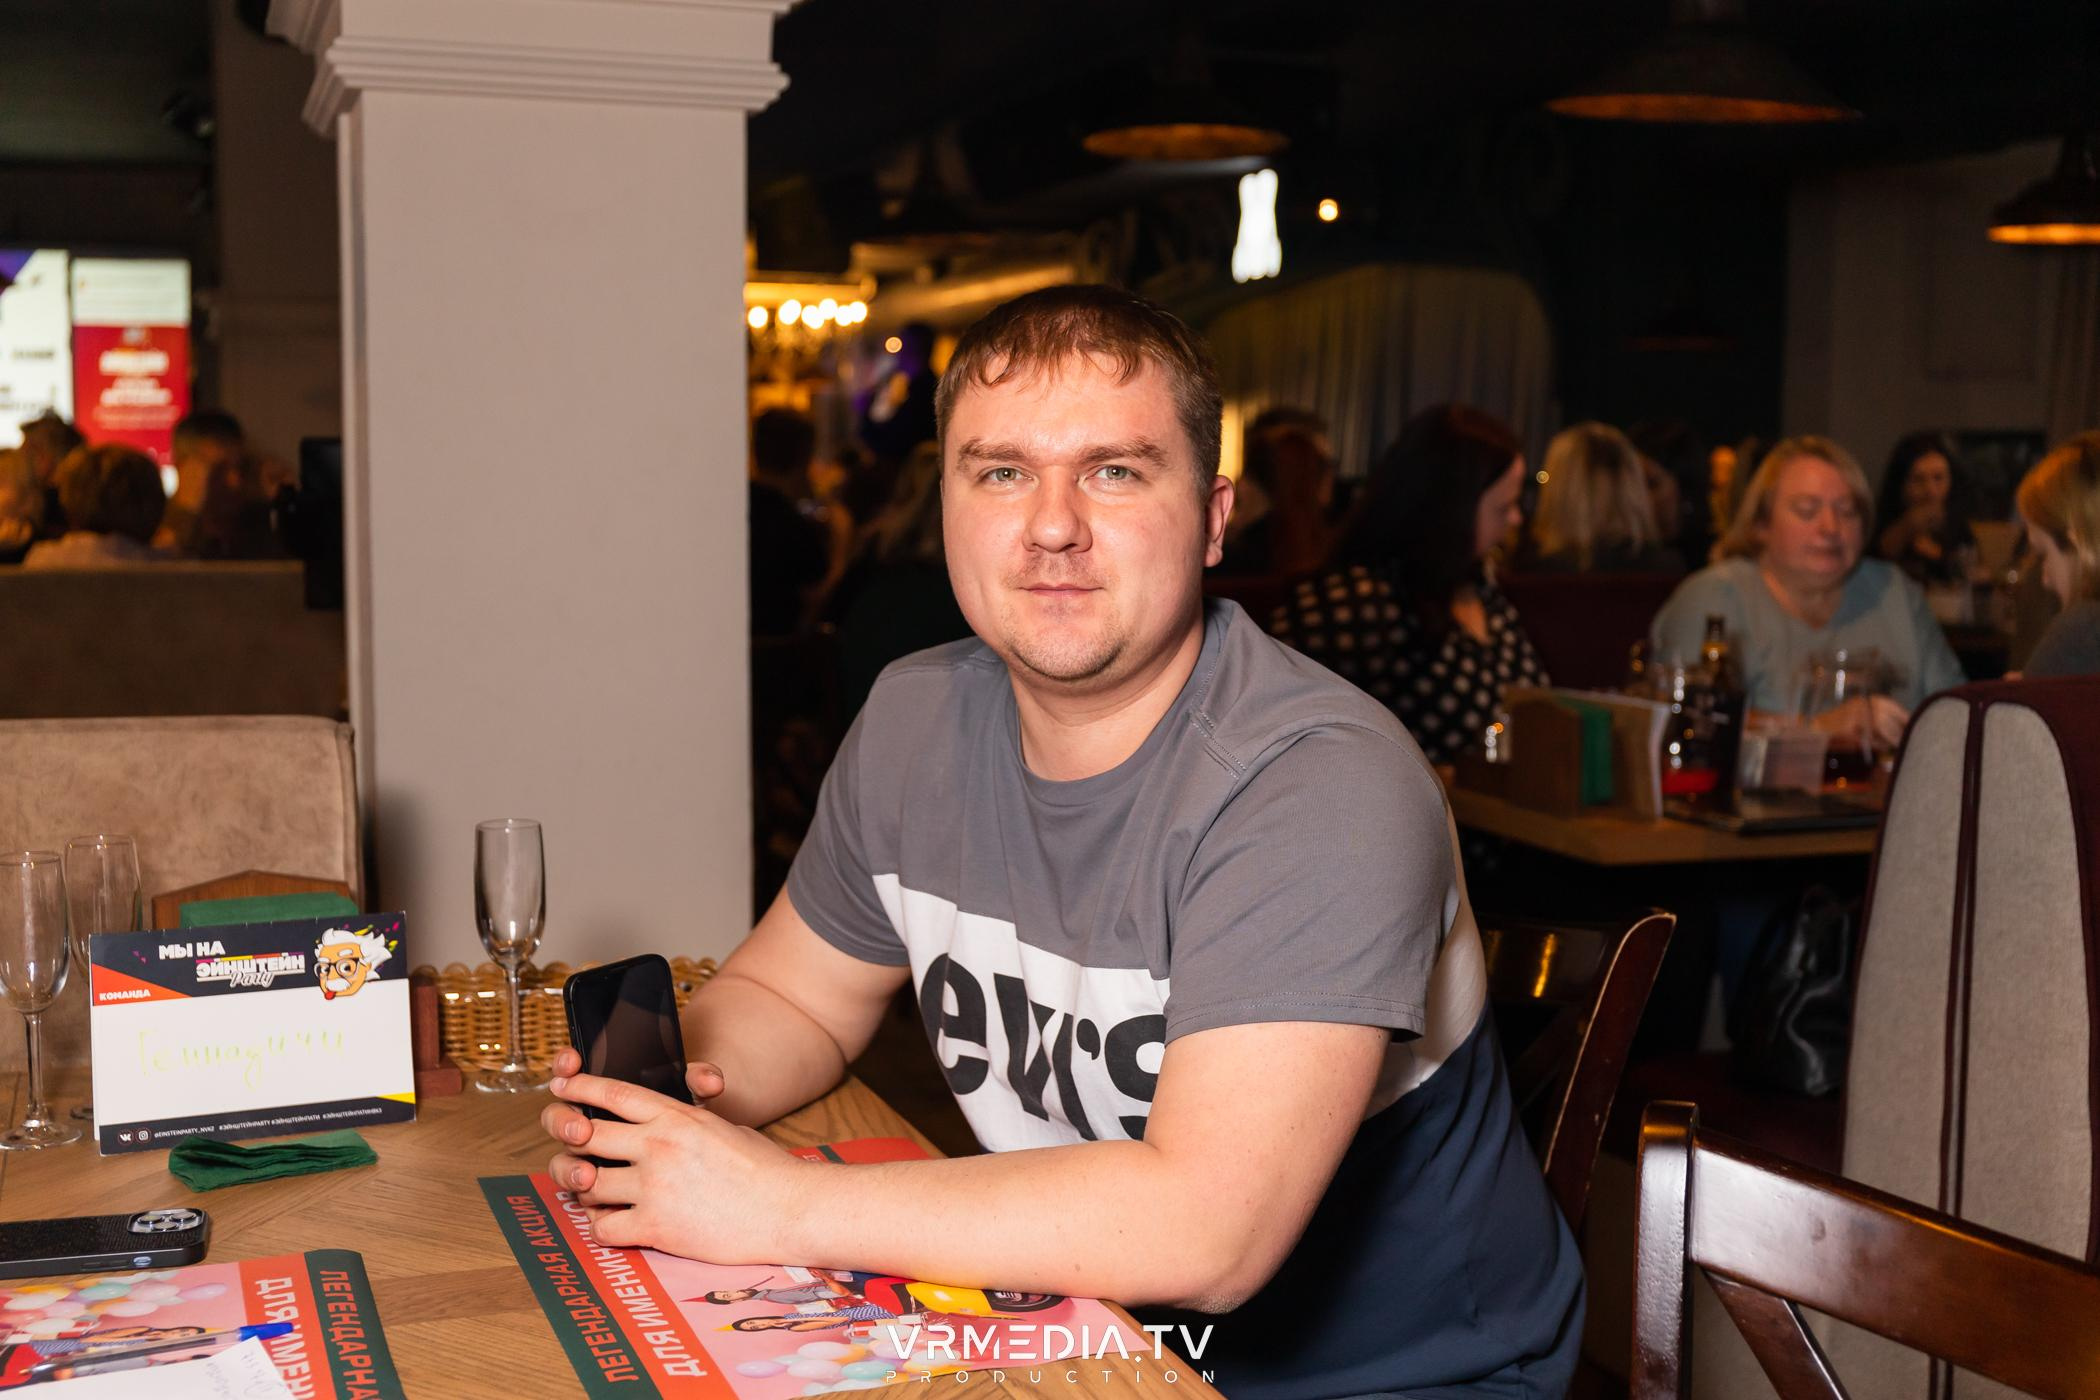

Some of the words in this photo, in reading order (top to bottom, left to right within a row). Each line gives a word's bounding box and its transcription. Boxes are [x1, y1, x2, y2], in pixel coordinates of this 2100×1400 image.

[158, 943, 193, 960] МЫ
[196, 940, 226, 957] НА
[196, 952, 305, 977] ЭЙНШТЕЙН
[99, 989, 151, 1001] КОМАНДА
[229, 970, 275, 988] Party
[506, 1194, 559, 1247] АКЦИЯ
[255, 1277, 299, 1325] ДЛЯ
[536, 1253, 639, 1383] ЛЕГЕНДАРНАЯ
[320, 1270, 383, 1400] ЛЕГЕНДАРНА
[642, 1330, 707, 1377] ДЛЯ
